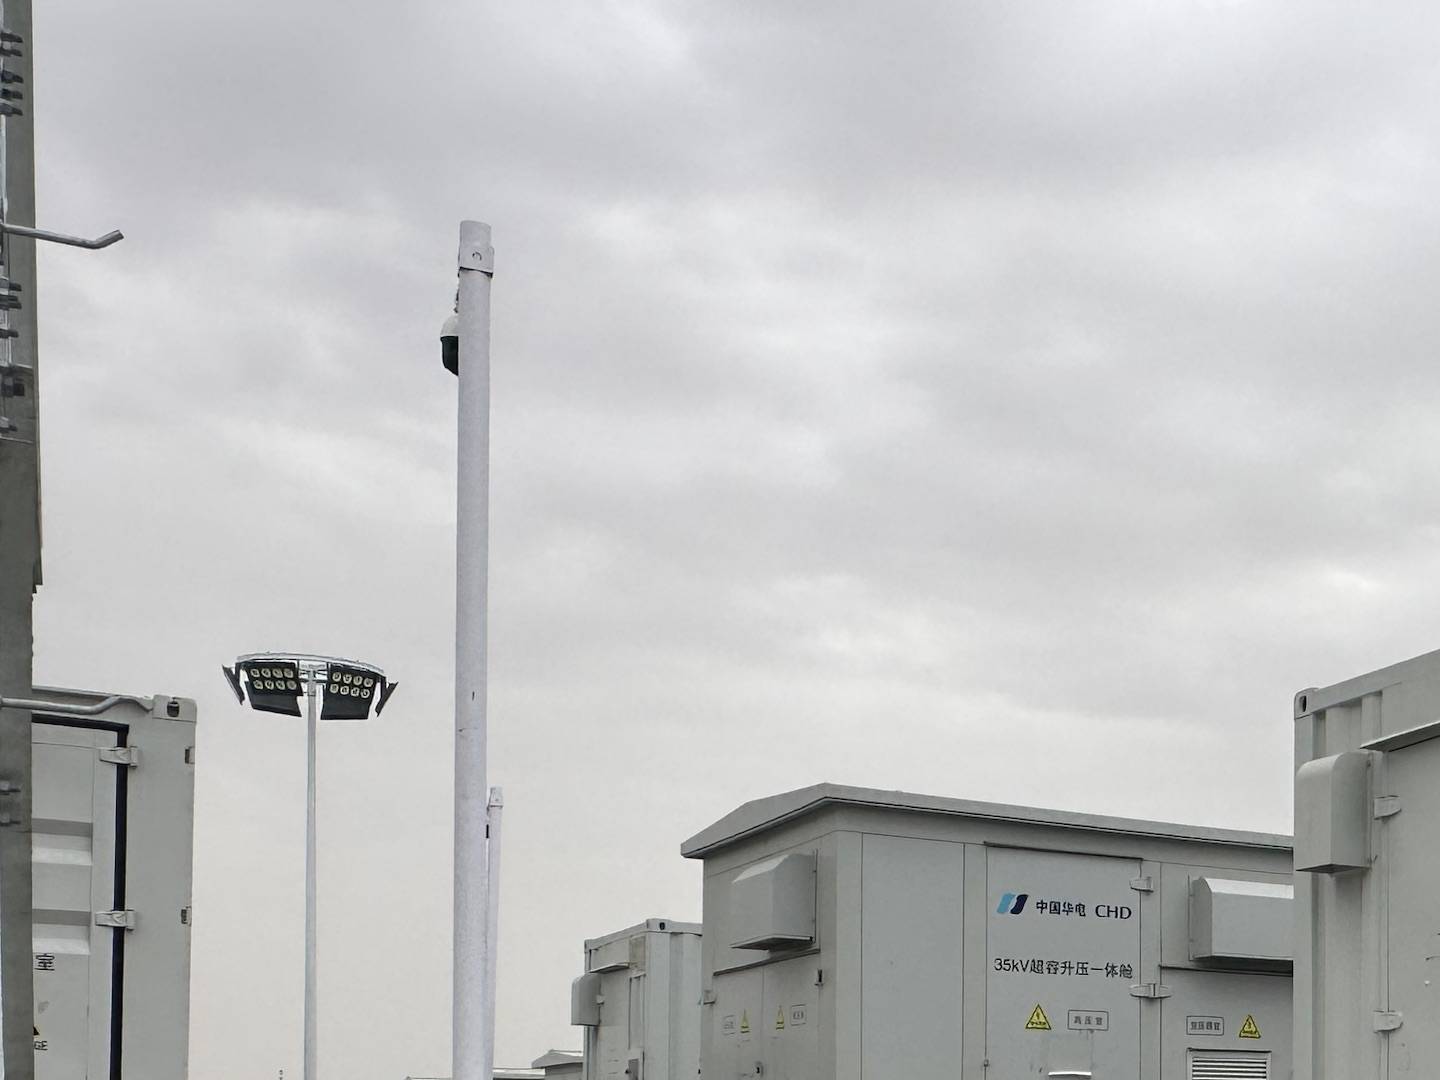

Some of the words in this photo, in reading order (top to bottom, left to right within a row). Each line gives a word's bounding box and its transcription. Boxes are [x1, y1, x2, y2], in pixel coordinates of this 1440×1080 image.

[1036, 900, 1087, 917] 中国华电
[1095, 905, 1132, 919] CHD
